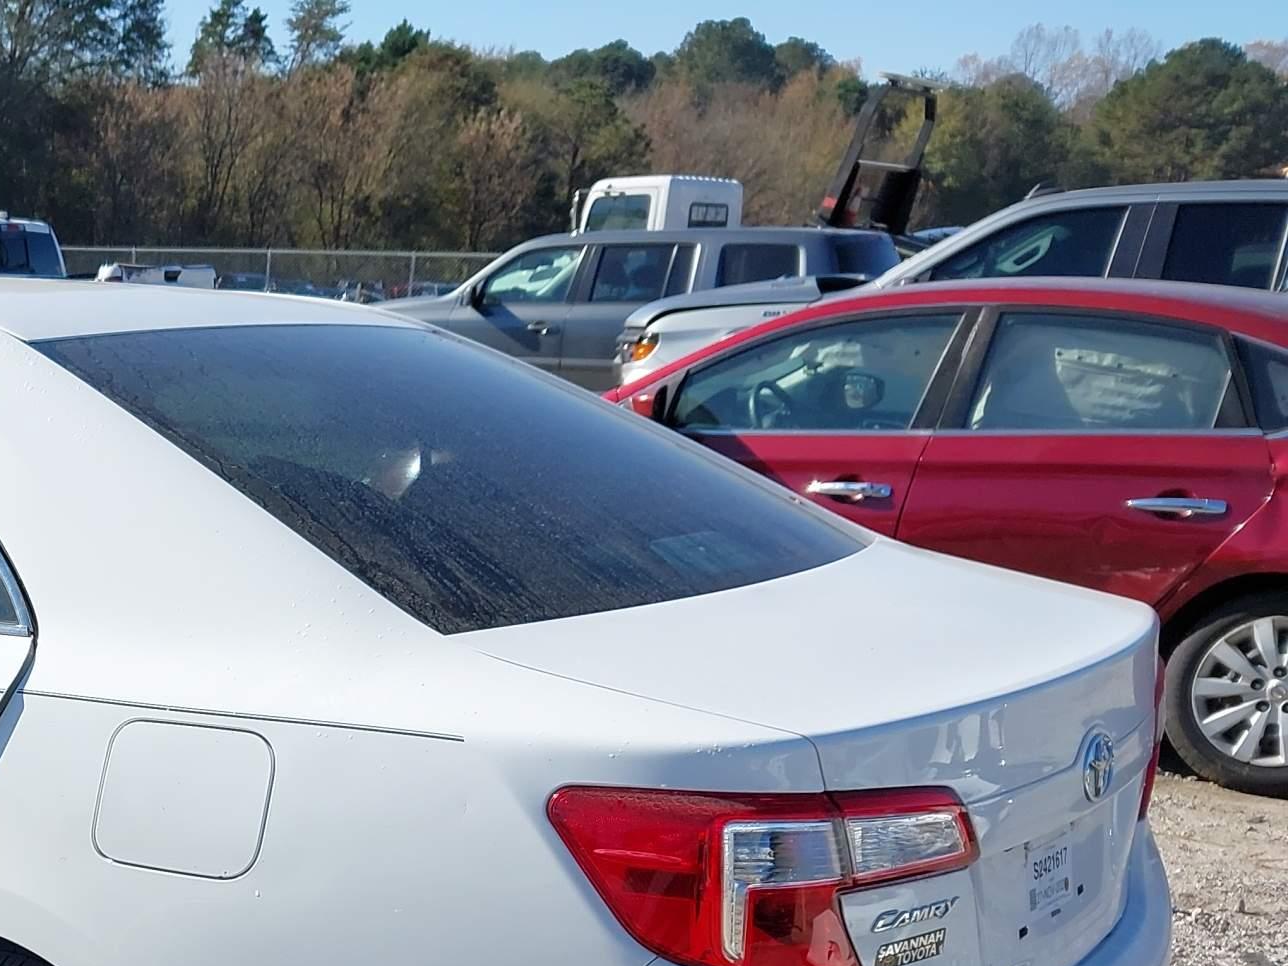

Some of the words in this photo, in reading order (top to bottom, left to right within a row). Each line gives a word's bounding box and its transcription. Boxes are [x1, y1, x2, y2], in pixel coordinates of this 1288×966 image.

[1033, 846, 1068, 881] S2421617
[871, 895, 961, 934] CAMRY
[878, 929, 944, 962] SAVANNAH
[896, 944, 937, 966] TOYOTA
